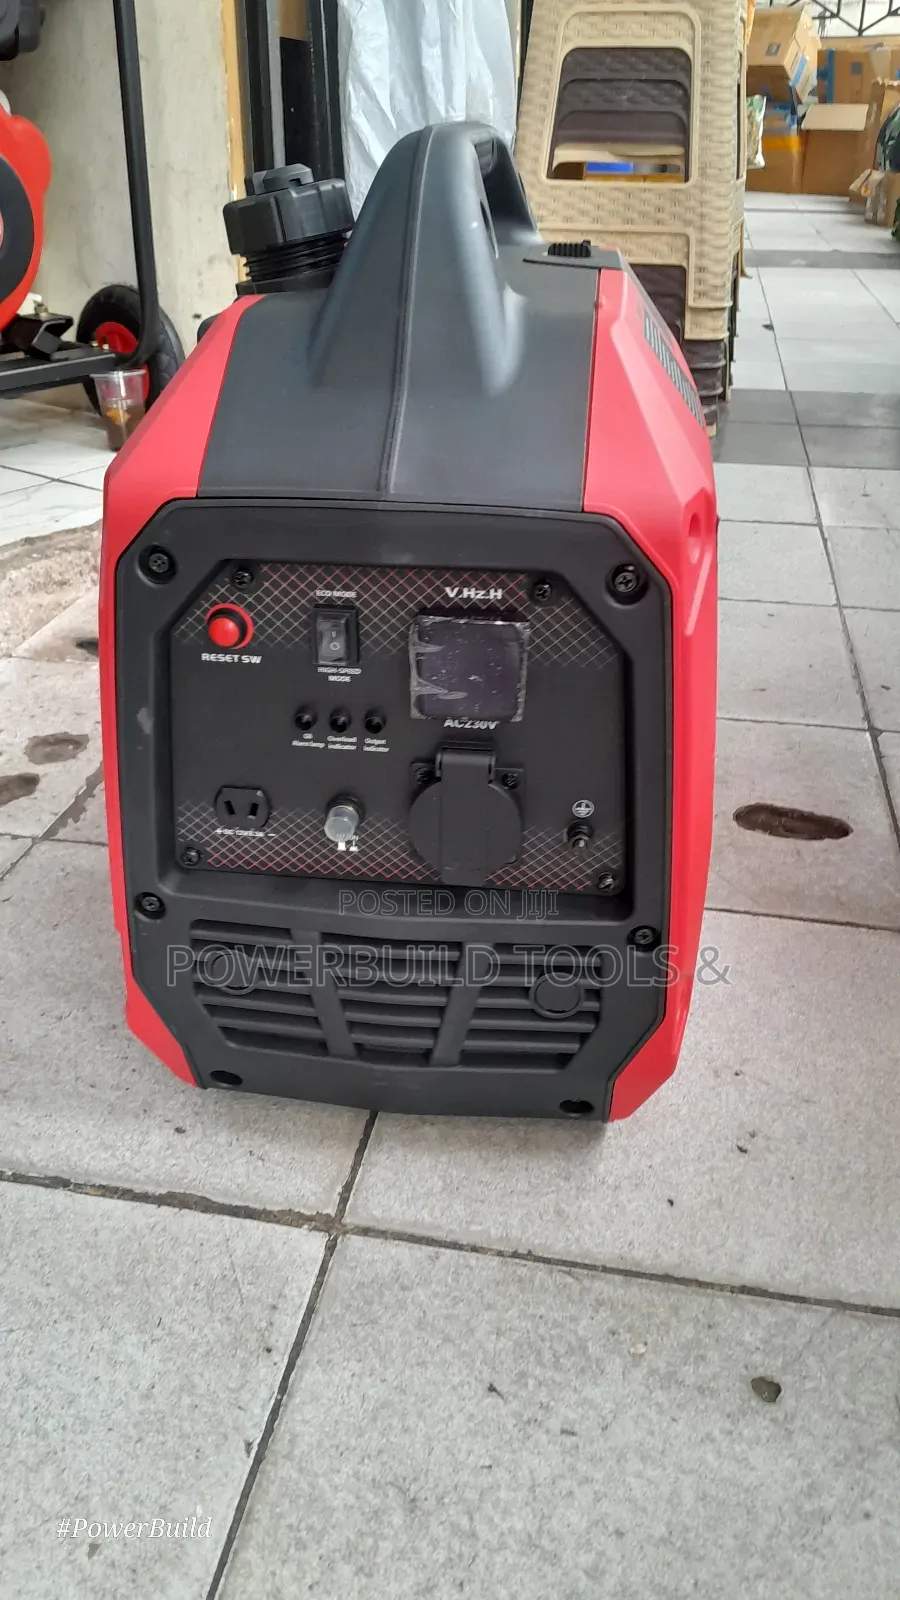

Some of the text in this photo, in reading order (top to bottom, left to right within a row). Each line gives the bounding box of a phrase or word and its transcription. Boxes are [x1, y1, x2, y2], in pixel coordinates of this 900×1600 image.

[332, 590, 358, 599] MODE
[201, 653, 262, 664] RESET SW
[327, 675, 352, 683] MODE
